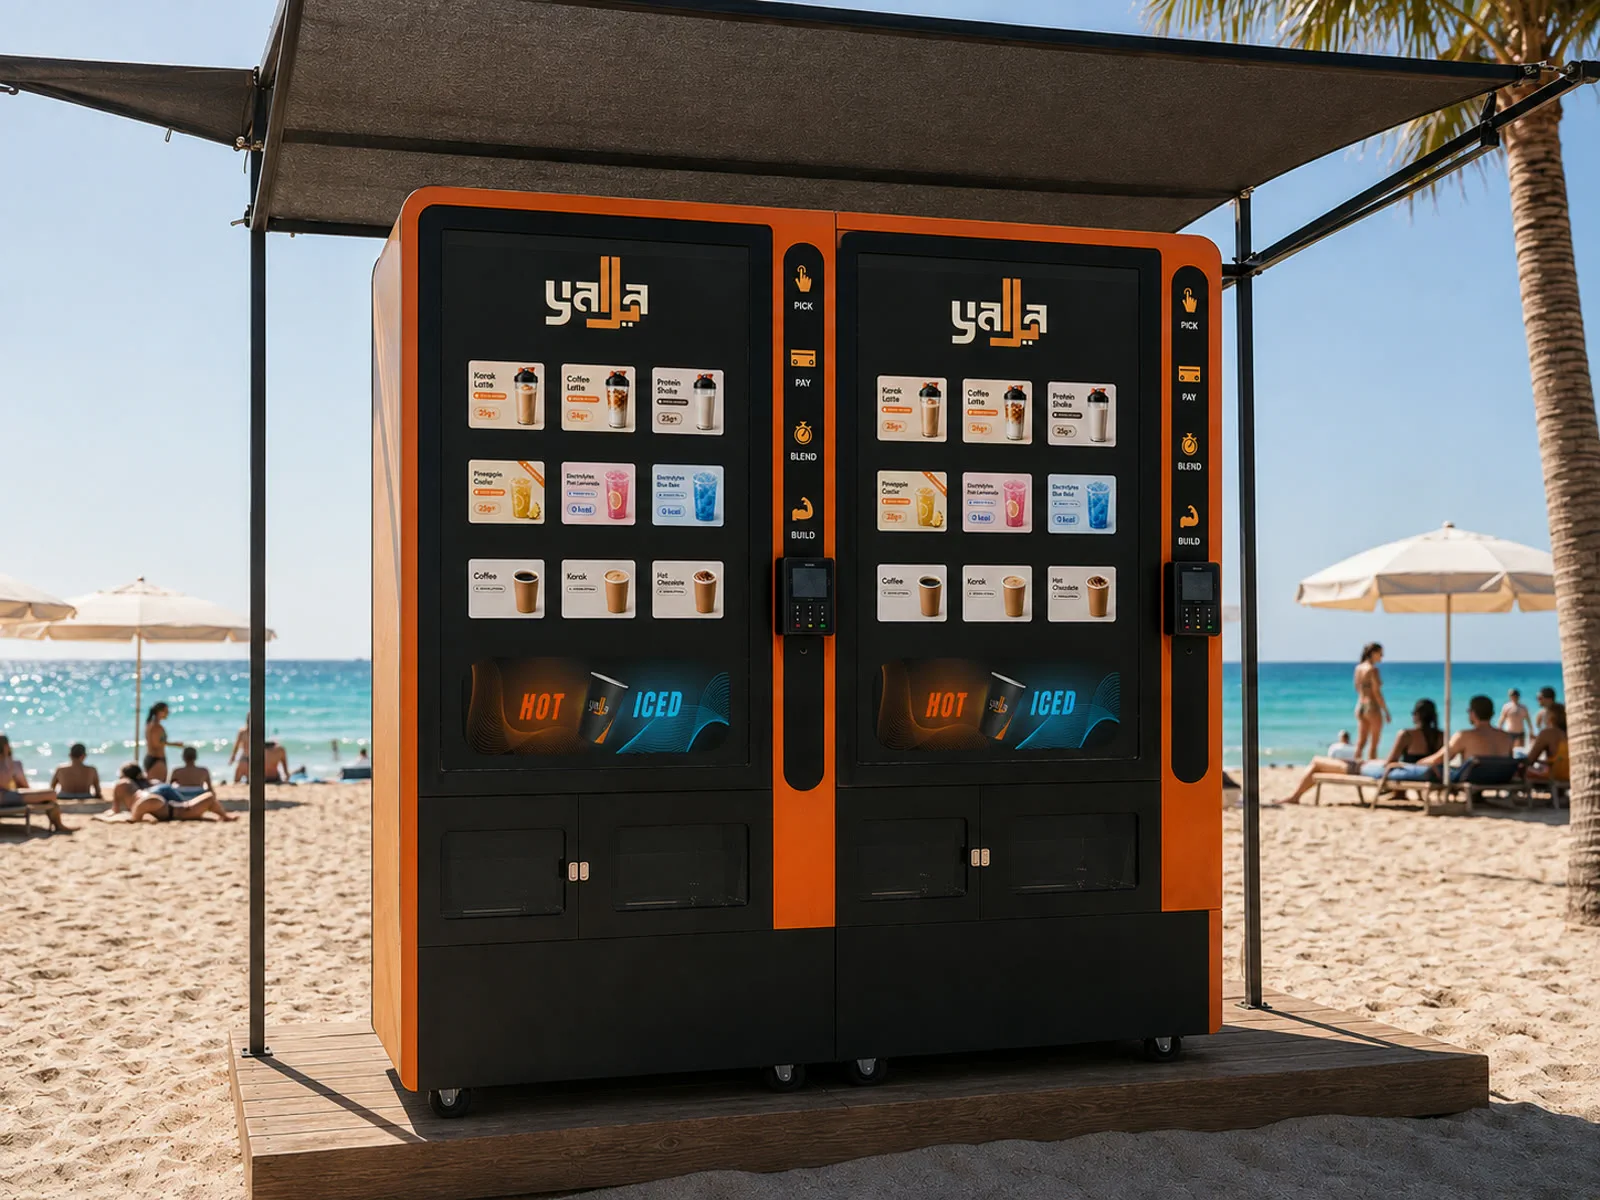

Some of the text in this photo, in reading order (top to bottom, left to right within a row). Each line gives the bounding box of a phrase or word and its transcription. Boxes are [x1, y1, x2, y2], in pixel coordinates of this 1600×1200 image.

[545, 256, 648, 326] yalla
[793, 301, 814, 310] PICK
[952, 278, 1047, 345] yalla
[1180, 321, 1199, 330] PICK
[566, 375, 590, 384] Coffee
[656, 378, 681, 387] Protein
[795, 378, 811, 387] PAY
[967, 389, 990, 398] Coffee
[1052, 392, 1075, 401] Protein
[1182, 393, 1197, 401] PAY
[882, 395, 900, 403] Latte
[790, 452, 817, 461] BLEND
[1177, 461, 1202, 471] BLEND
[791, 531, 816, 540] BUILD
[1178, 537, 1201, 546] BUILD
[473, 571, 498, 580] Coffee
[881, 577, 904, 585] Coffee
[519, 693, 566, 721] HOT
[632, 691, 683, 718] ICED
[925, 692, 968, 718] HOT
[1029, 690, 1077, 716] ICED
